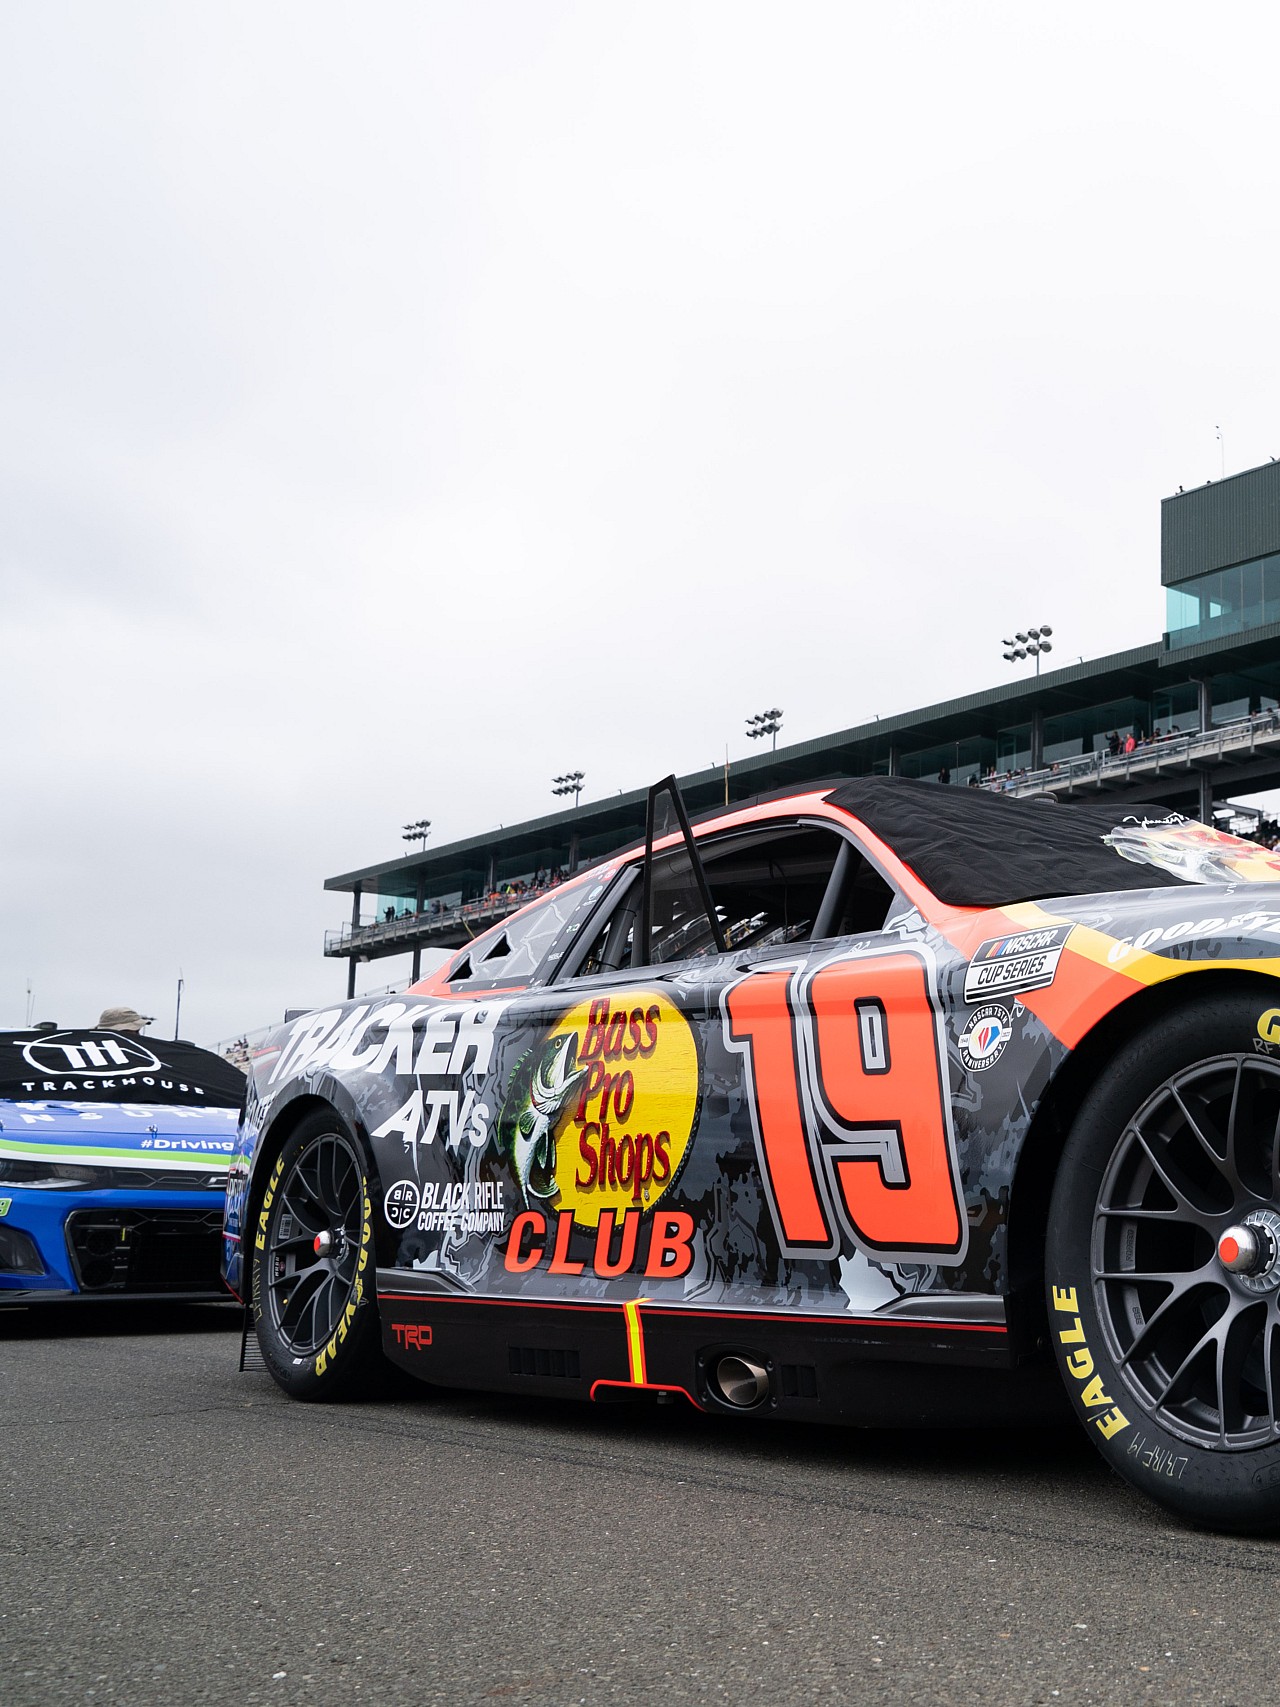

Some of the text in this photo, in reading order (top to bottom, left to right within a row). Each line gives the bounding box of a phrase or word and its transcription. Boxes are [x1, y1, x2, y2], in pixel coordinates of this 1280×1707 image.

[1001, 930, 1059, 955] NASCAR
[977, 955, 1047, 985] CUP SERIES
[577, 998, 661, 1060] Bass
[968, 1006, 1008, 1030] NASCAR 75TH
[268, 1000, 517, 1085] TRACKER
[962, 1043, 1003, 1070] ANNIVERSARY
[22, 1076, 205, 1095] TRACKHOUSE
[574, 1060, 635, 1122] Pro
[722, 950, 965, 1258] 19
[370, 1089, 490, 1148] ATVs
[141, 1138, 235, 1151] #Driving
[575, 1121, 671, 1200] Shops
[255, 1151, 285, 1251] EAGLE
[420, 1181, 505, 1210] BLACK RIFLE
[417, 1211, 505, 1232] COFFEE COMPANY
[503, 1208, 697, 1280] CLUB
[391, 1323, 433, 1350] TRD
[1052, 1285, 1131, 1441] EAGLE
